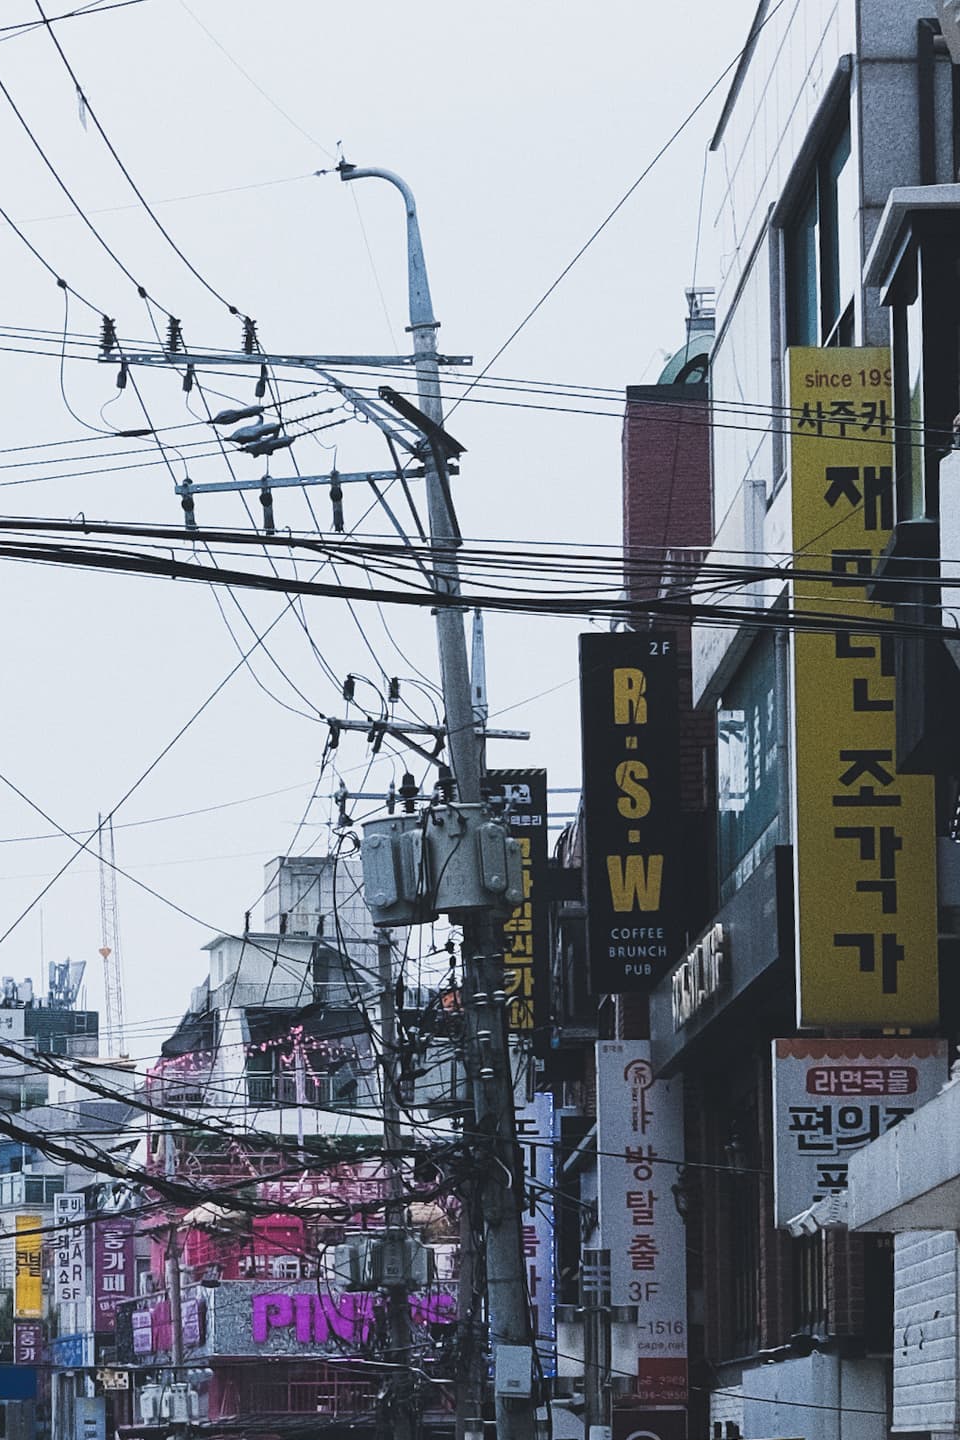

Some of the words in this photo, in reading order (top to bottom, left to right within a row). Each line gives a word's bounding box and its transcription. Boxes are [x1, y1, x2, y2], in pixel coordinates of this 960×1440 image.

[805, 369, 852, 388] since
[857, 367, 894, 388] 199
[797, 400, 890, 438] 사주카
[649, 641, 669, 656] 2F
[832, 749, 905, 995] 조각가
[611, 927, 665, 940] COFFEE
[608, 944, 667, 958] BRUNCH
[624, 963, 652, 976] PUB
[815, 1069, 909, 1094] 라면국물
[625, 1143, 659, 1272] 방탈출
[628, 1281, 660, 1302] 3F
